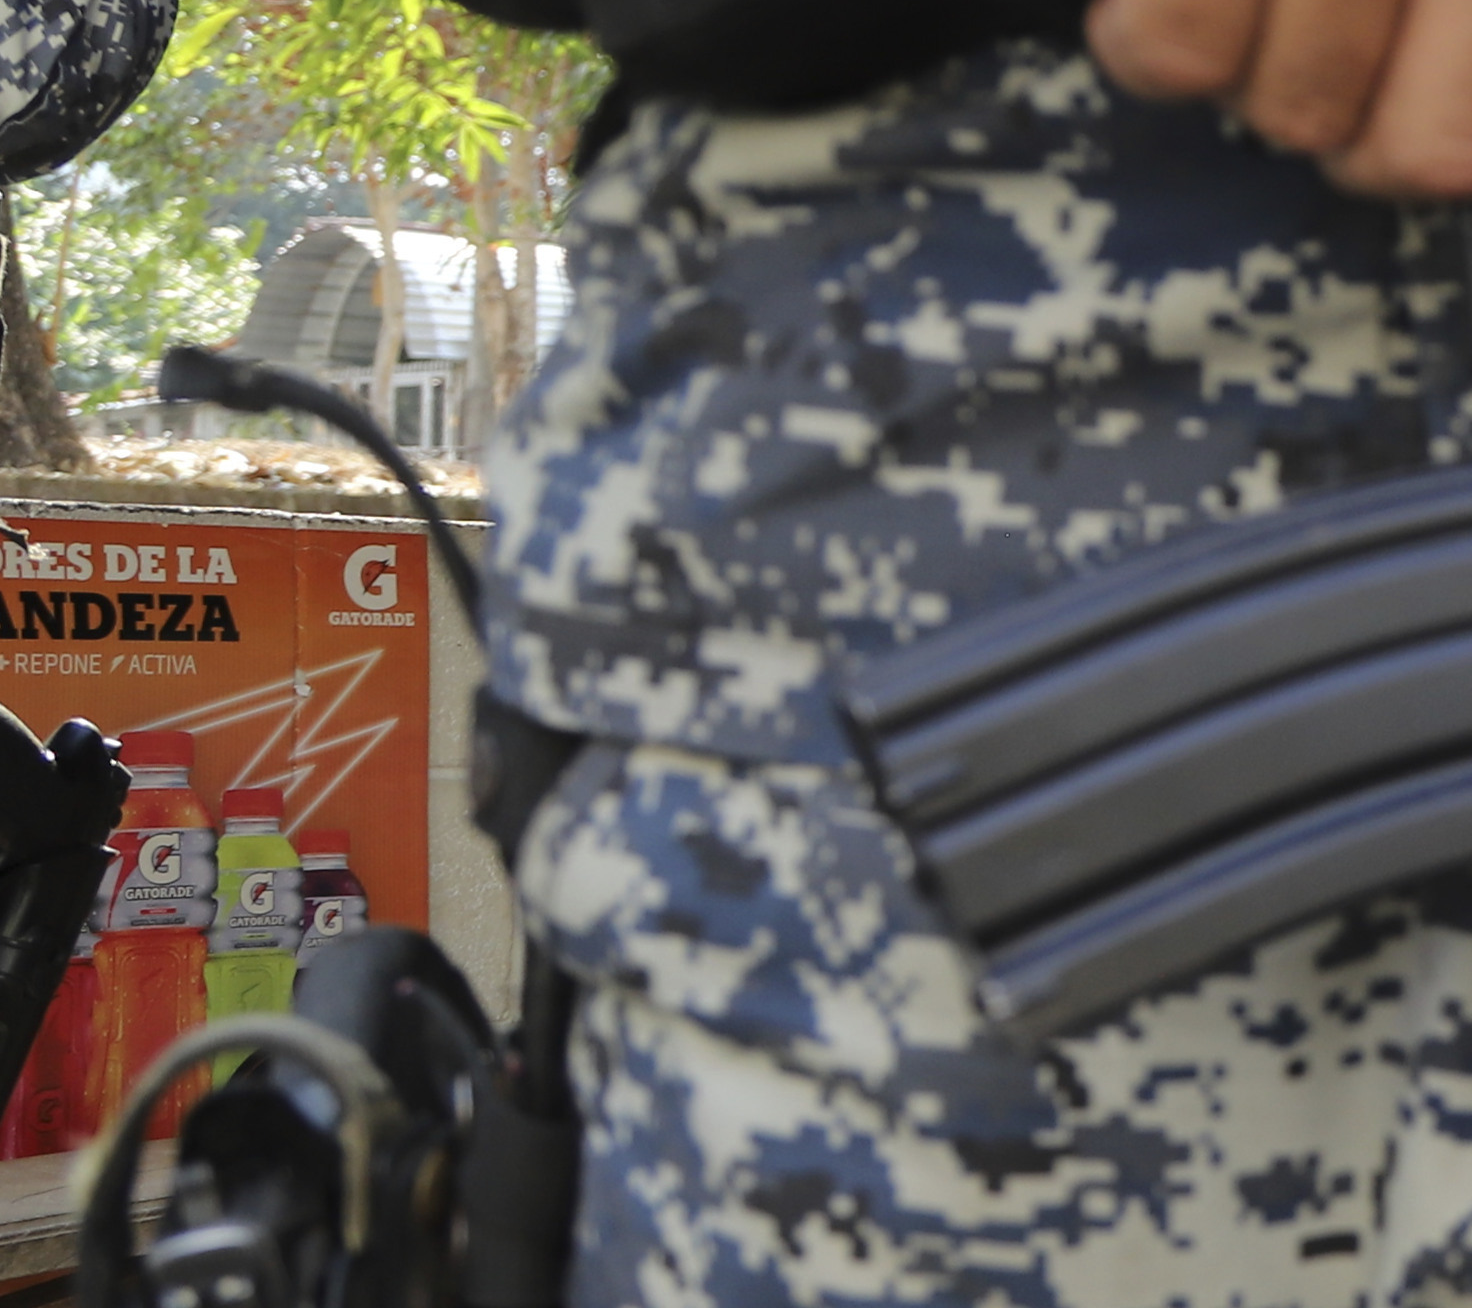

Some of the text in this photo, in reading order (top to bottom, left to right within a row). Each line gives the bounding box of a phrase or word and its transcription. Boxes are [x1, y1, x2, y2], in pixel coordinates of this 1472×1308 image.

[0, 542, 238, 584] RES DE LA
[344, 545, 398, 611] G
[329, 612, 416, 627] GATORADE
[14, 654, 196, 675] REPONE ACTIVA
[138, 832, 182, 884] G
[125, 886, 194, 900] GATORADE
[241, 872, 274, 914] G
[229, 916, 285, 927] GATORADE
